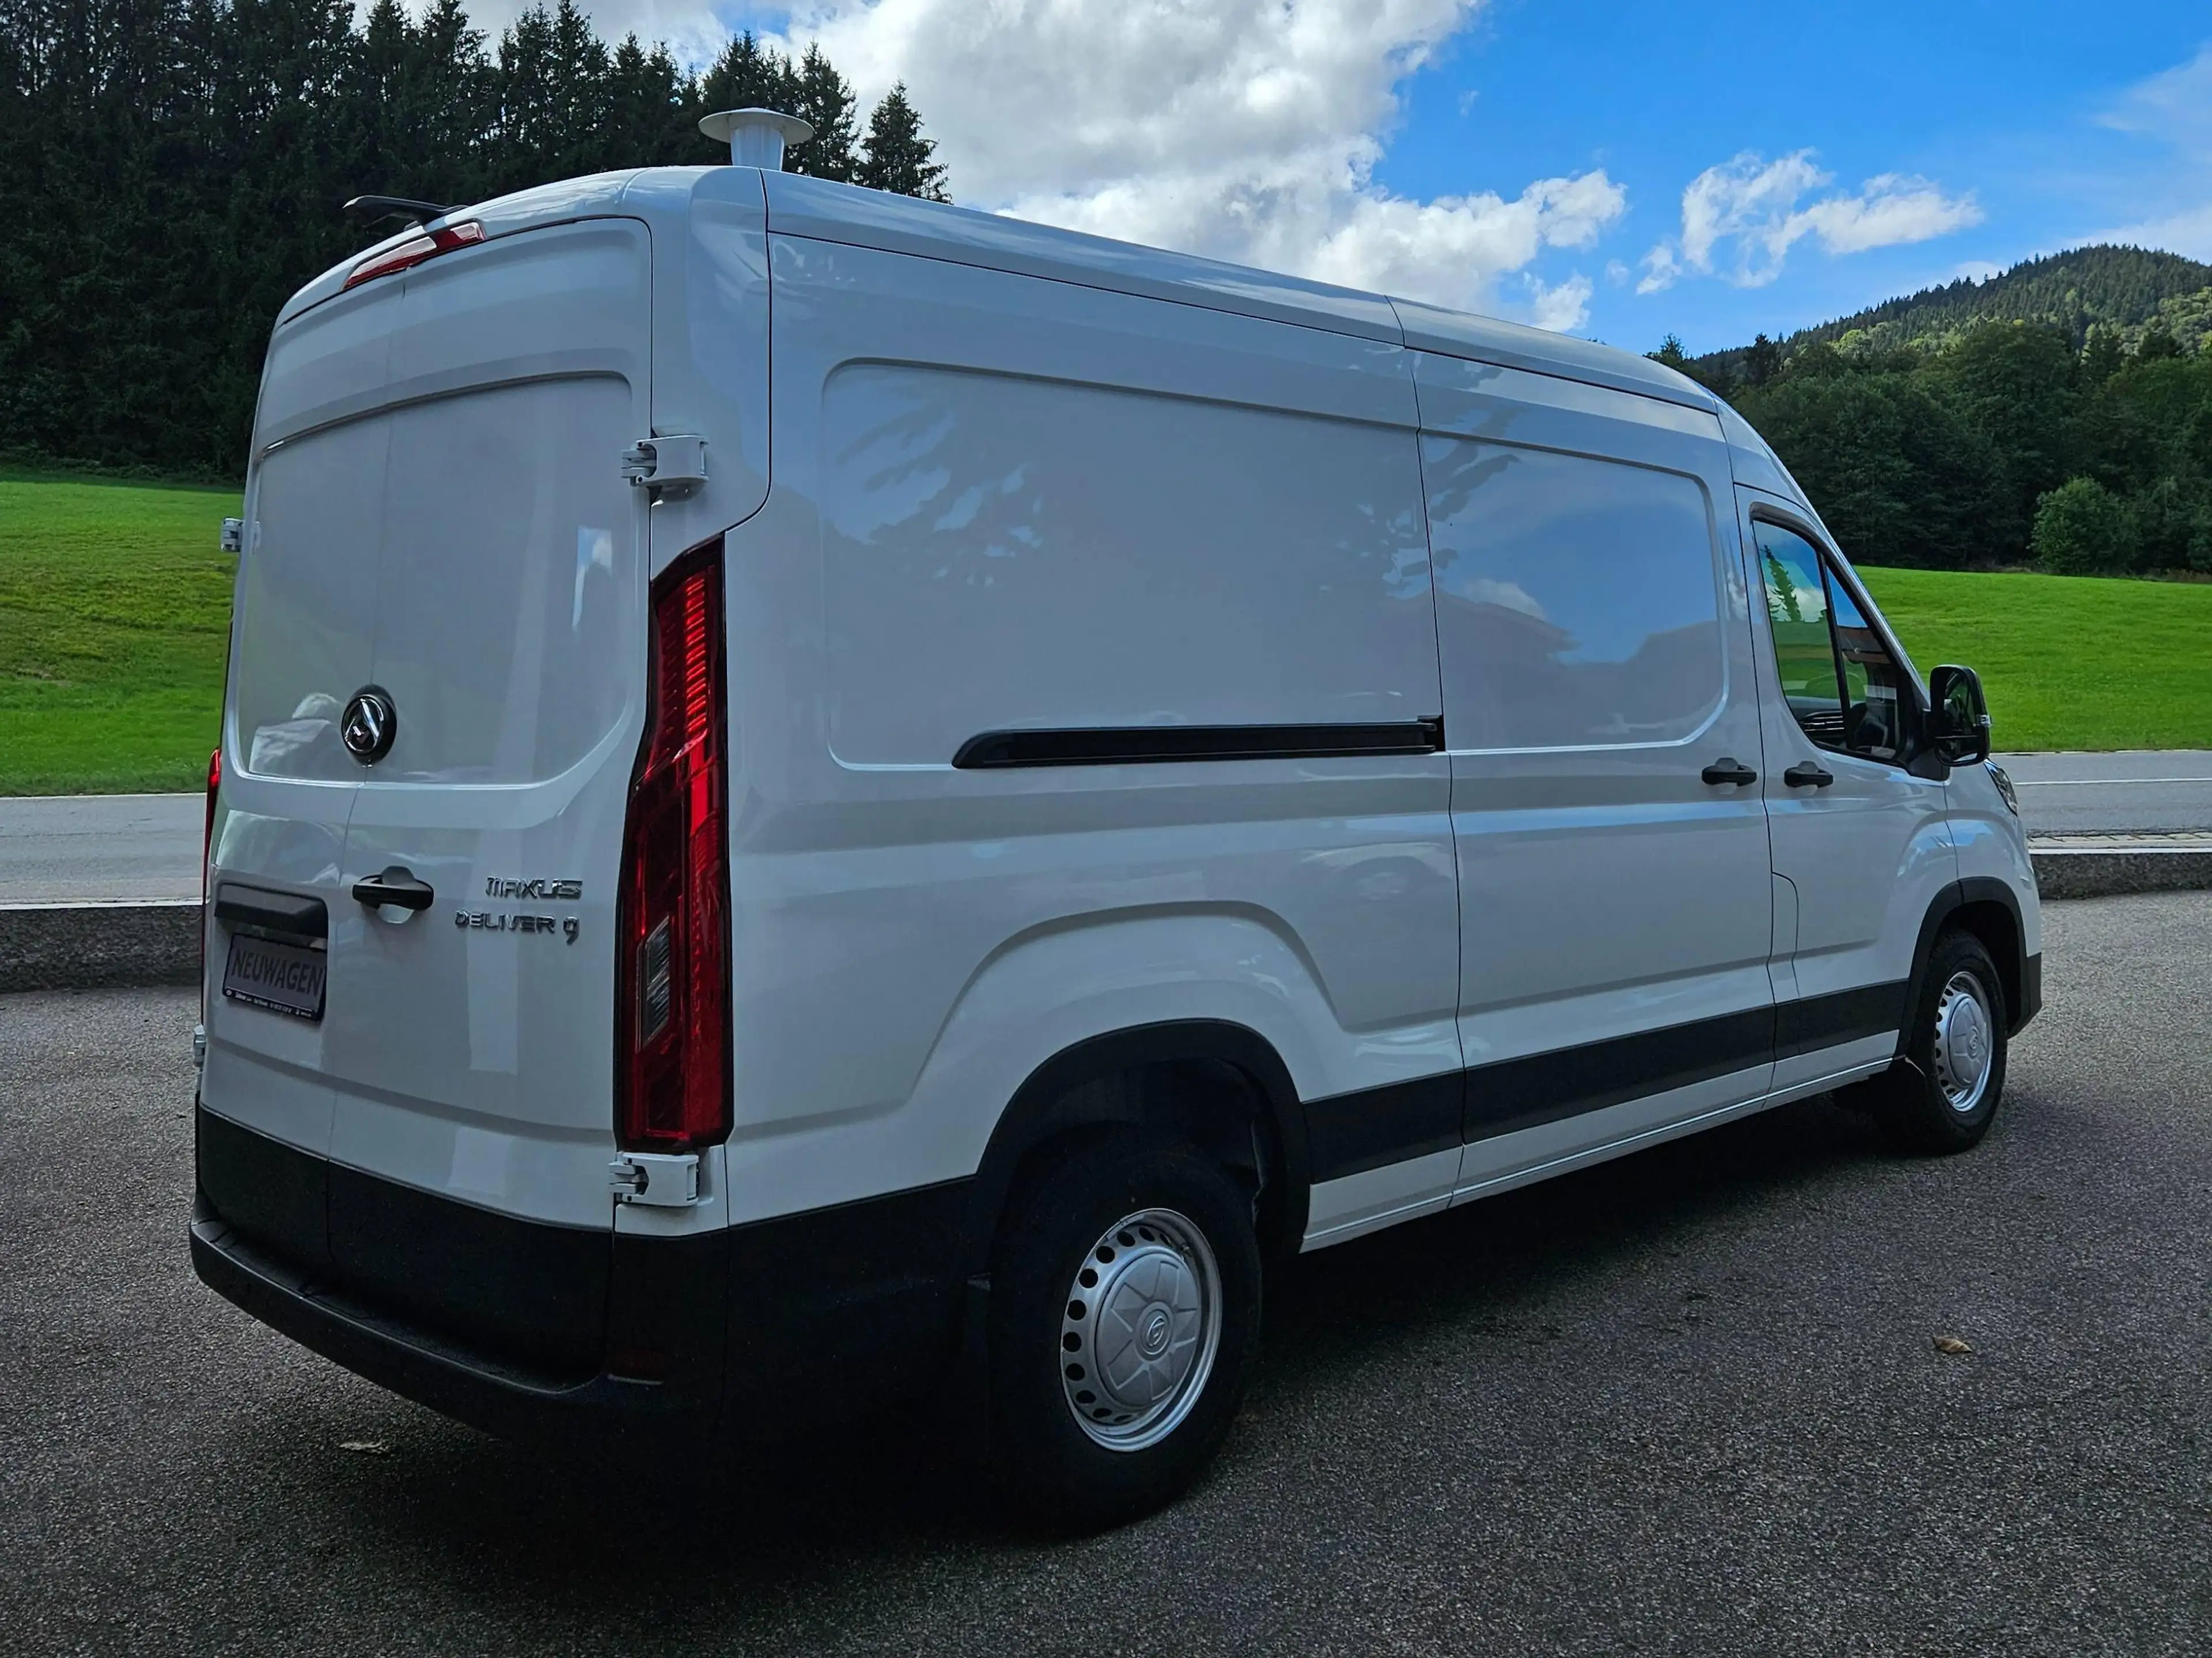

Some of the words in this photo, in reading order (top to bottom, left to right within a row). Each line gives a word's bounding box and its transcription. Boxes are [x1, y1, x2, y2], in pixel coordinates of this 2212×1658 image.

[485, 876, 582, 900] MAXUS
[454, 908, 556, 934] DELIVER
[563, 916, 579, 946] 9
[232, 948, 323, 996] NEUWAGEN
